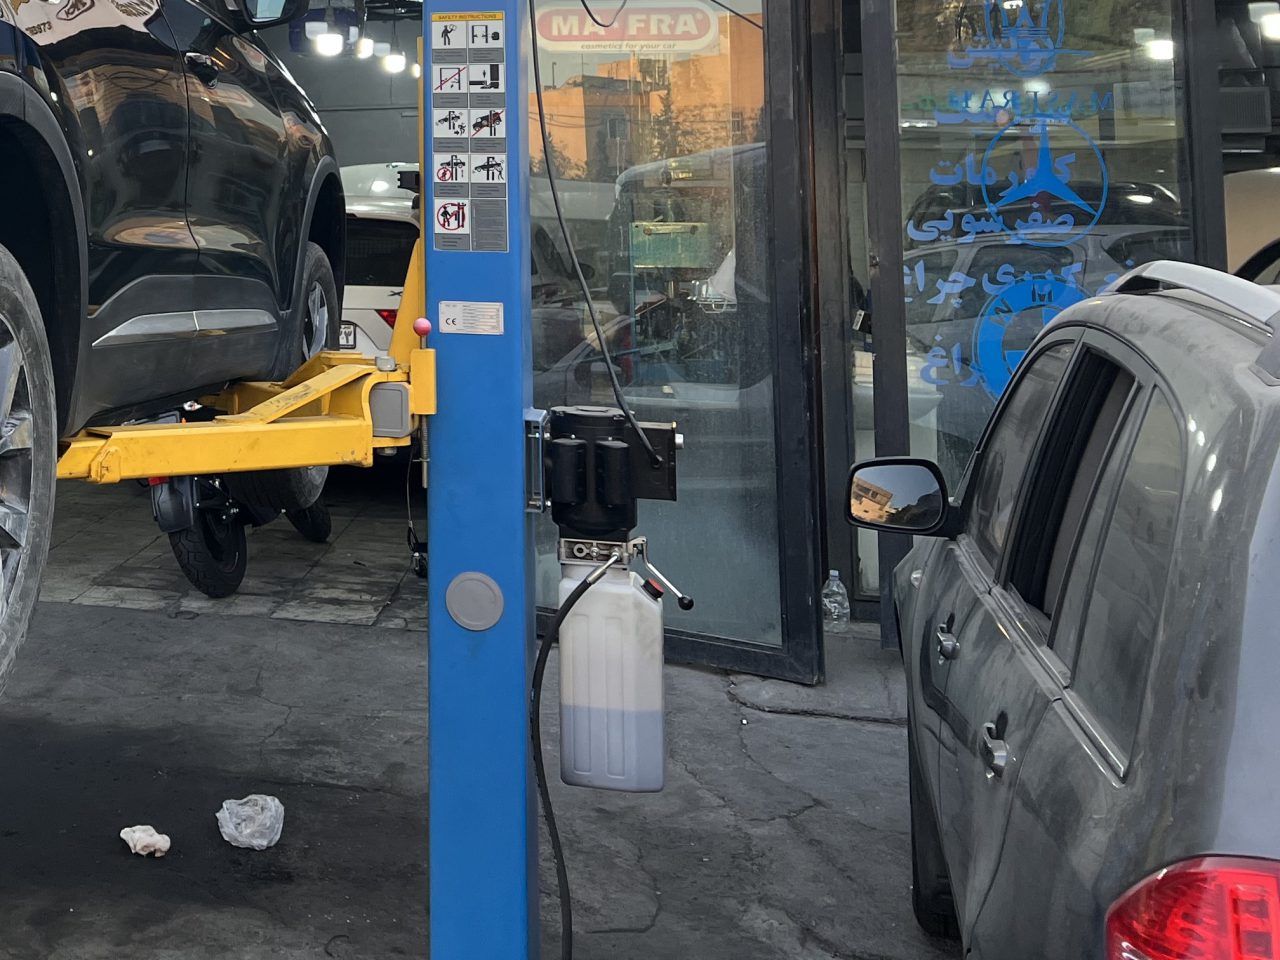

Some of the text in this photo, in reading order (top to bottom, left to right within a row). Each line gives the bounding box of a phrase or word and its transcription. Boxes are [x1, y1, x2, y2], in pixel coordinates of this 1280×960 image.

[581, 41, 677, 52] cosmetics for your car
